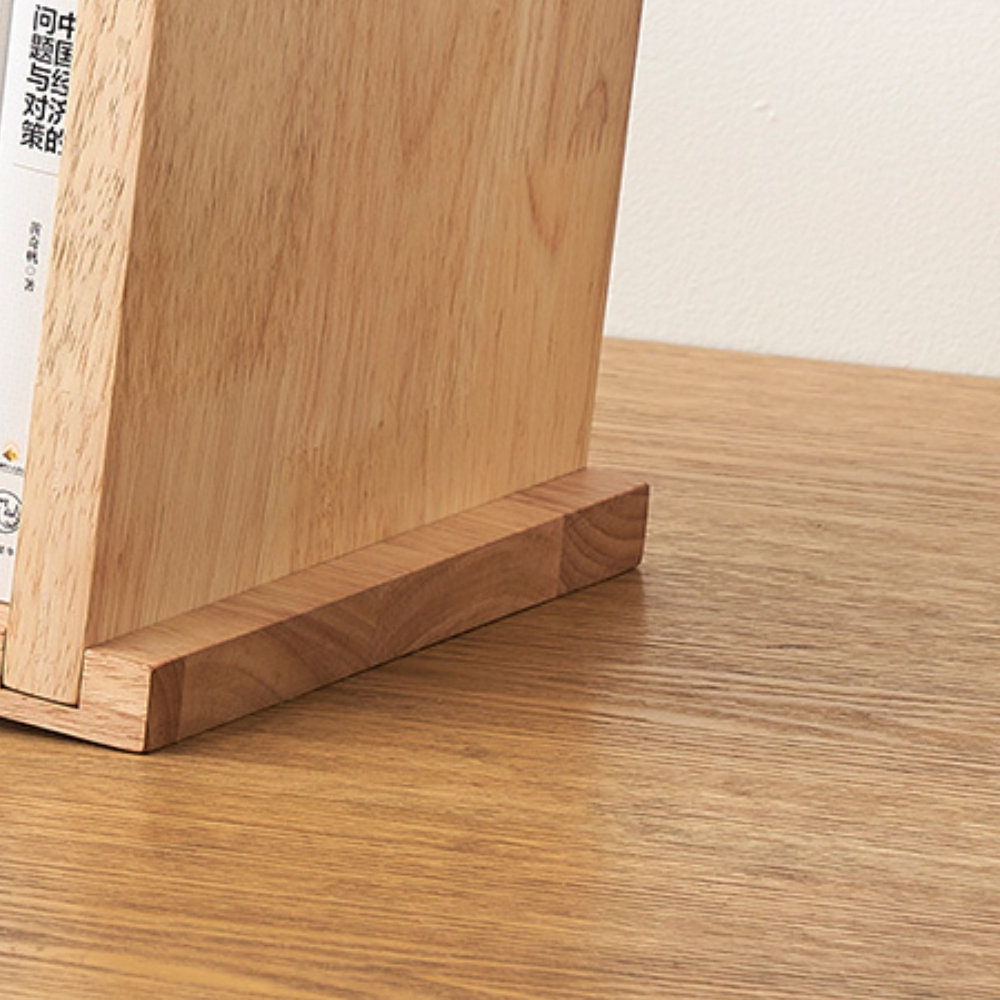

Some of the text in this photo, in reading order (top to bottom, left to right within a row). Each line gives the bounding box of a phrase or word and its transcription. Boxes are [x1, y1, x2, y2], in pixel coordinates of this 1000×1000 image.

[20, 4, 56, 151] 问题与对策
